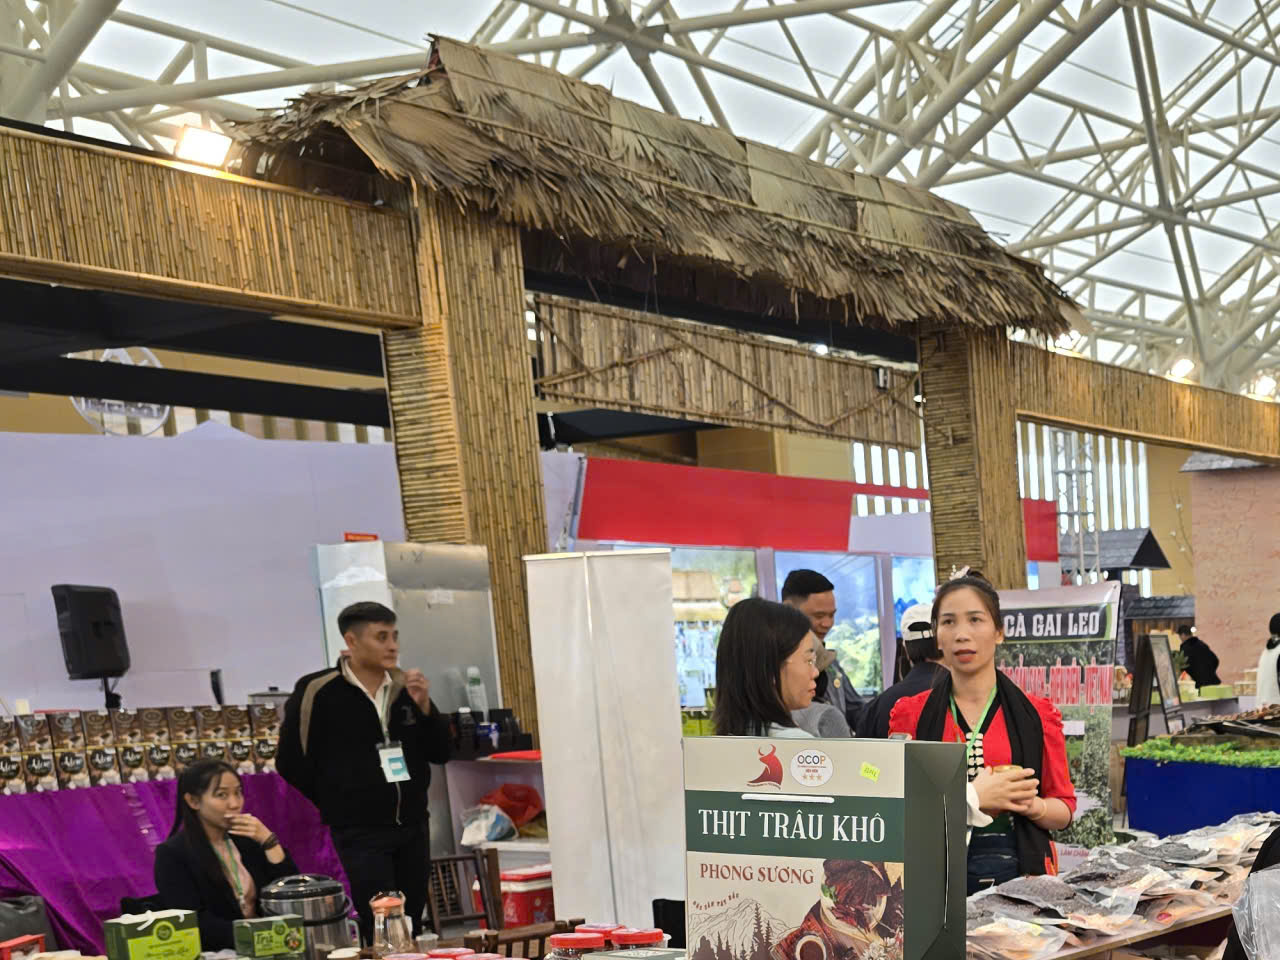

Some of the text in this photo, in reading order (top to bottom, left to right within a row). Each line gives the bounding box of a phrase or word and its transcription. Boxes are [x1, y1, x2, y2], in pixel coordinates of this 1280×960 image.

[1003, 612, 1100, 637] CÀ GAI LEO
[797, 755, 826, 764] OCOP
[698, 810, 885, 843] THỊT TRÂU KHÔ
[700, 863, 814, 884] PHONG SƯƠNG
